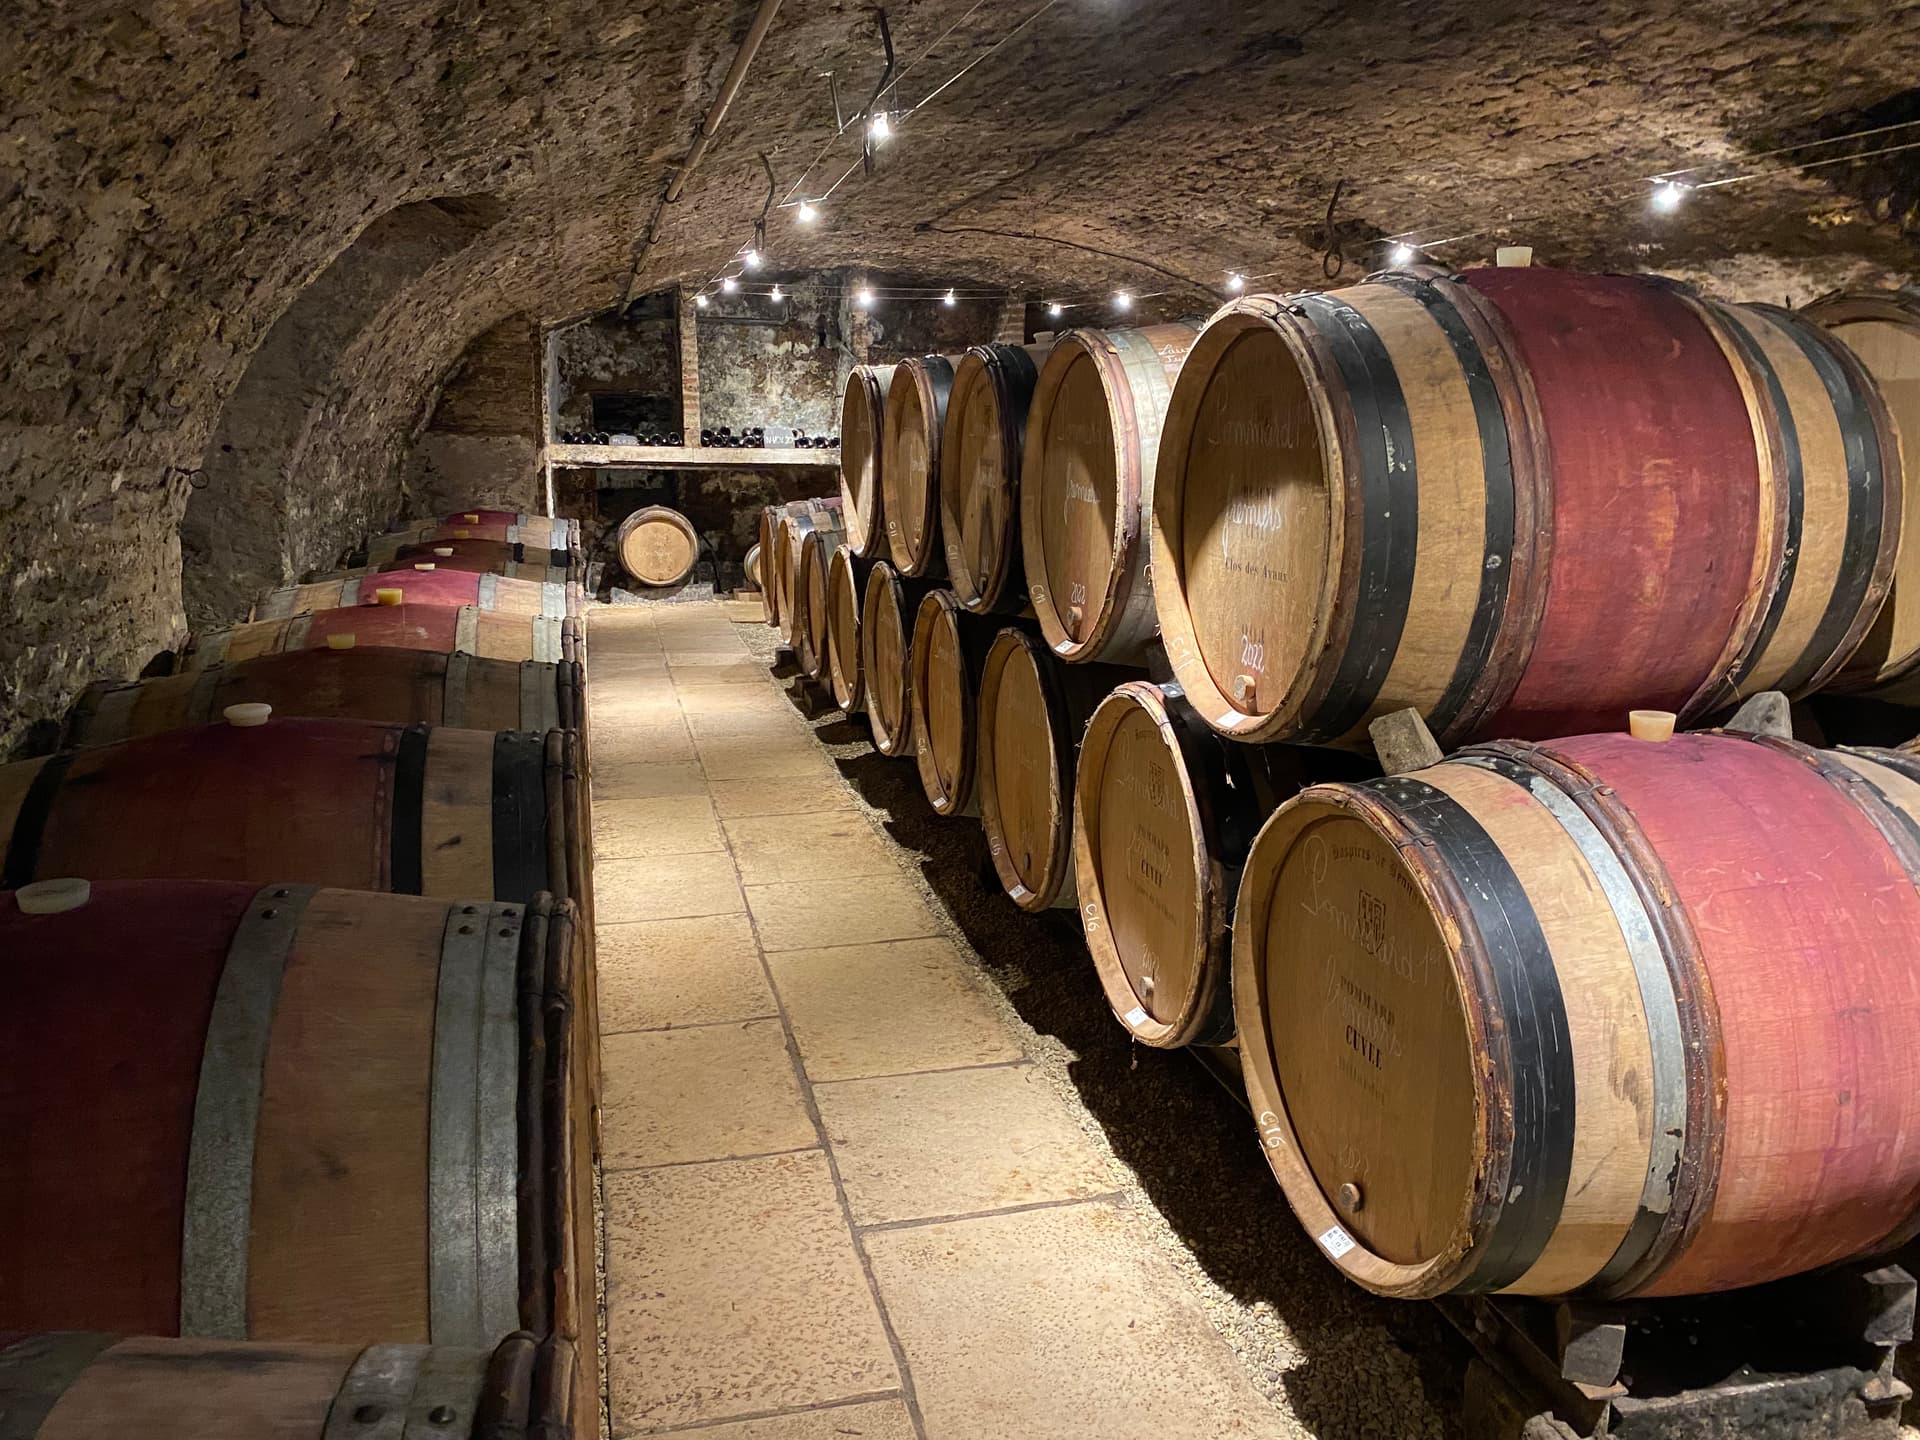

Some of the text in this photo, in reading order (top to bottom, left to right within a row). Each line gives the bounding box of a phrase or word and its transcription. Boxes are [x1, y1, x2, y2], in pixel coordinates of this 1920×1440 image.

[1225, 558, 1242, 572] Clos
[1245, 562, 1258, 575] des
[1241, 634, 1264, 673] 2022
[1085, 903, 1101, 932] C16
[1260, 1111, 1287, 1149] C16
